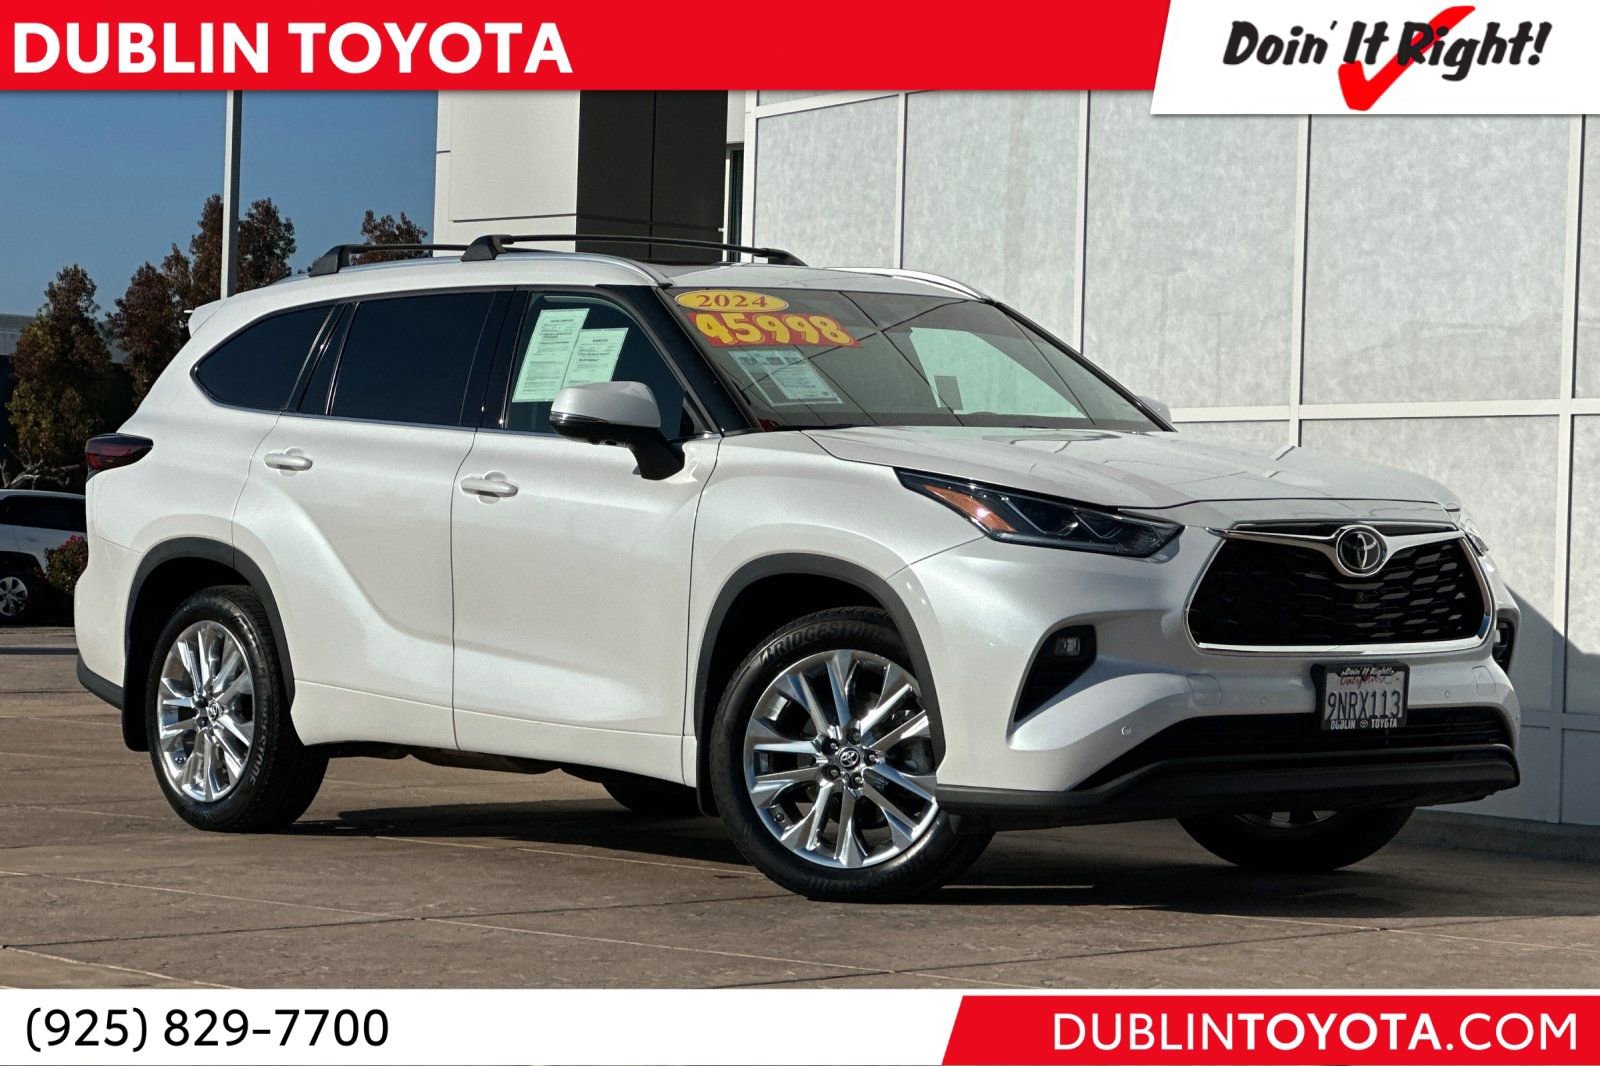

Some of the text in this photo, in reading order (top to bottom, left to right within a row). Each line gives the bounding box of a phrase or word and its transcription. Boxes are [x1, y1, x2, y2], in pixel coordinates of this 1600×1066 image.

[695, 294, 768, 308] 2024
[695, 312, 854, 345] 45998
[1326, 689, 1401, 720] 9NRX113
[1330, 718, 1398, 730] DUBLIN TOYOTA
